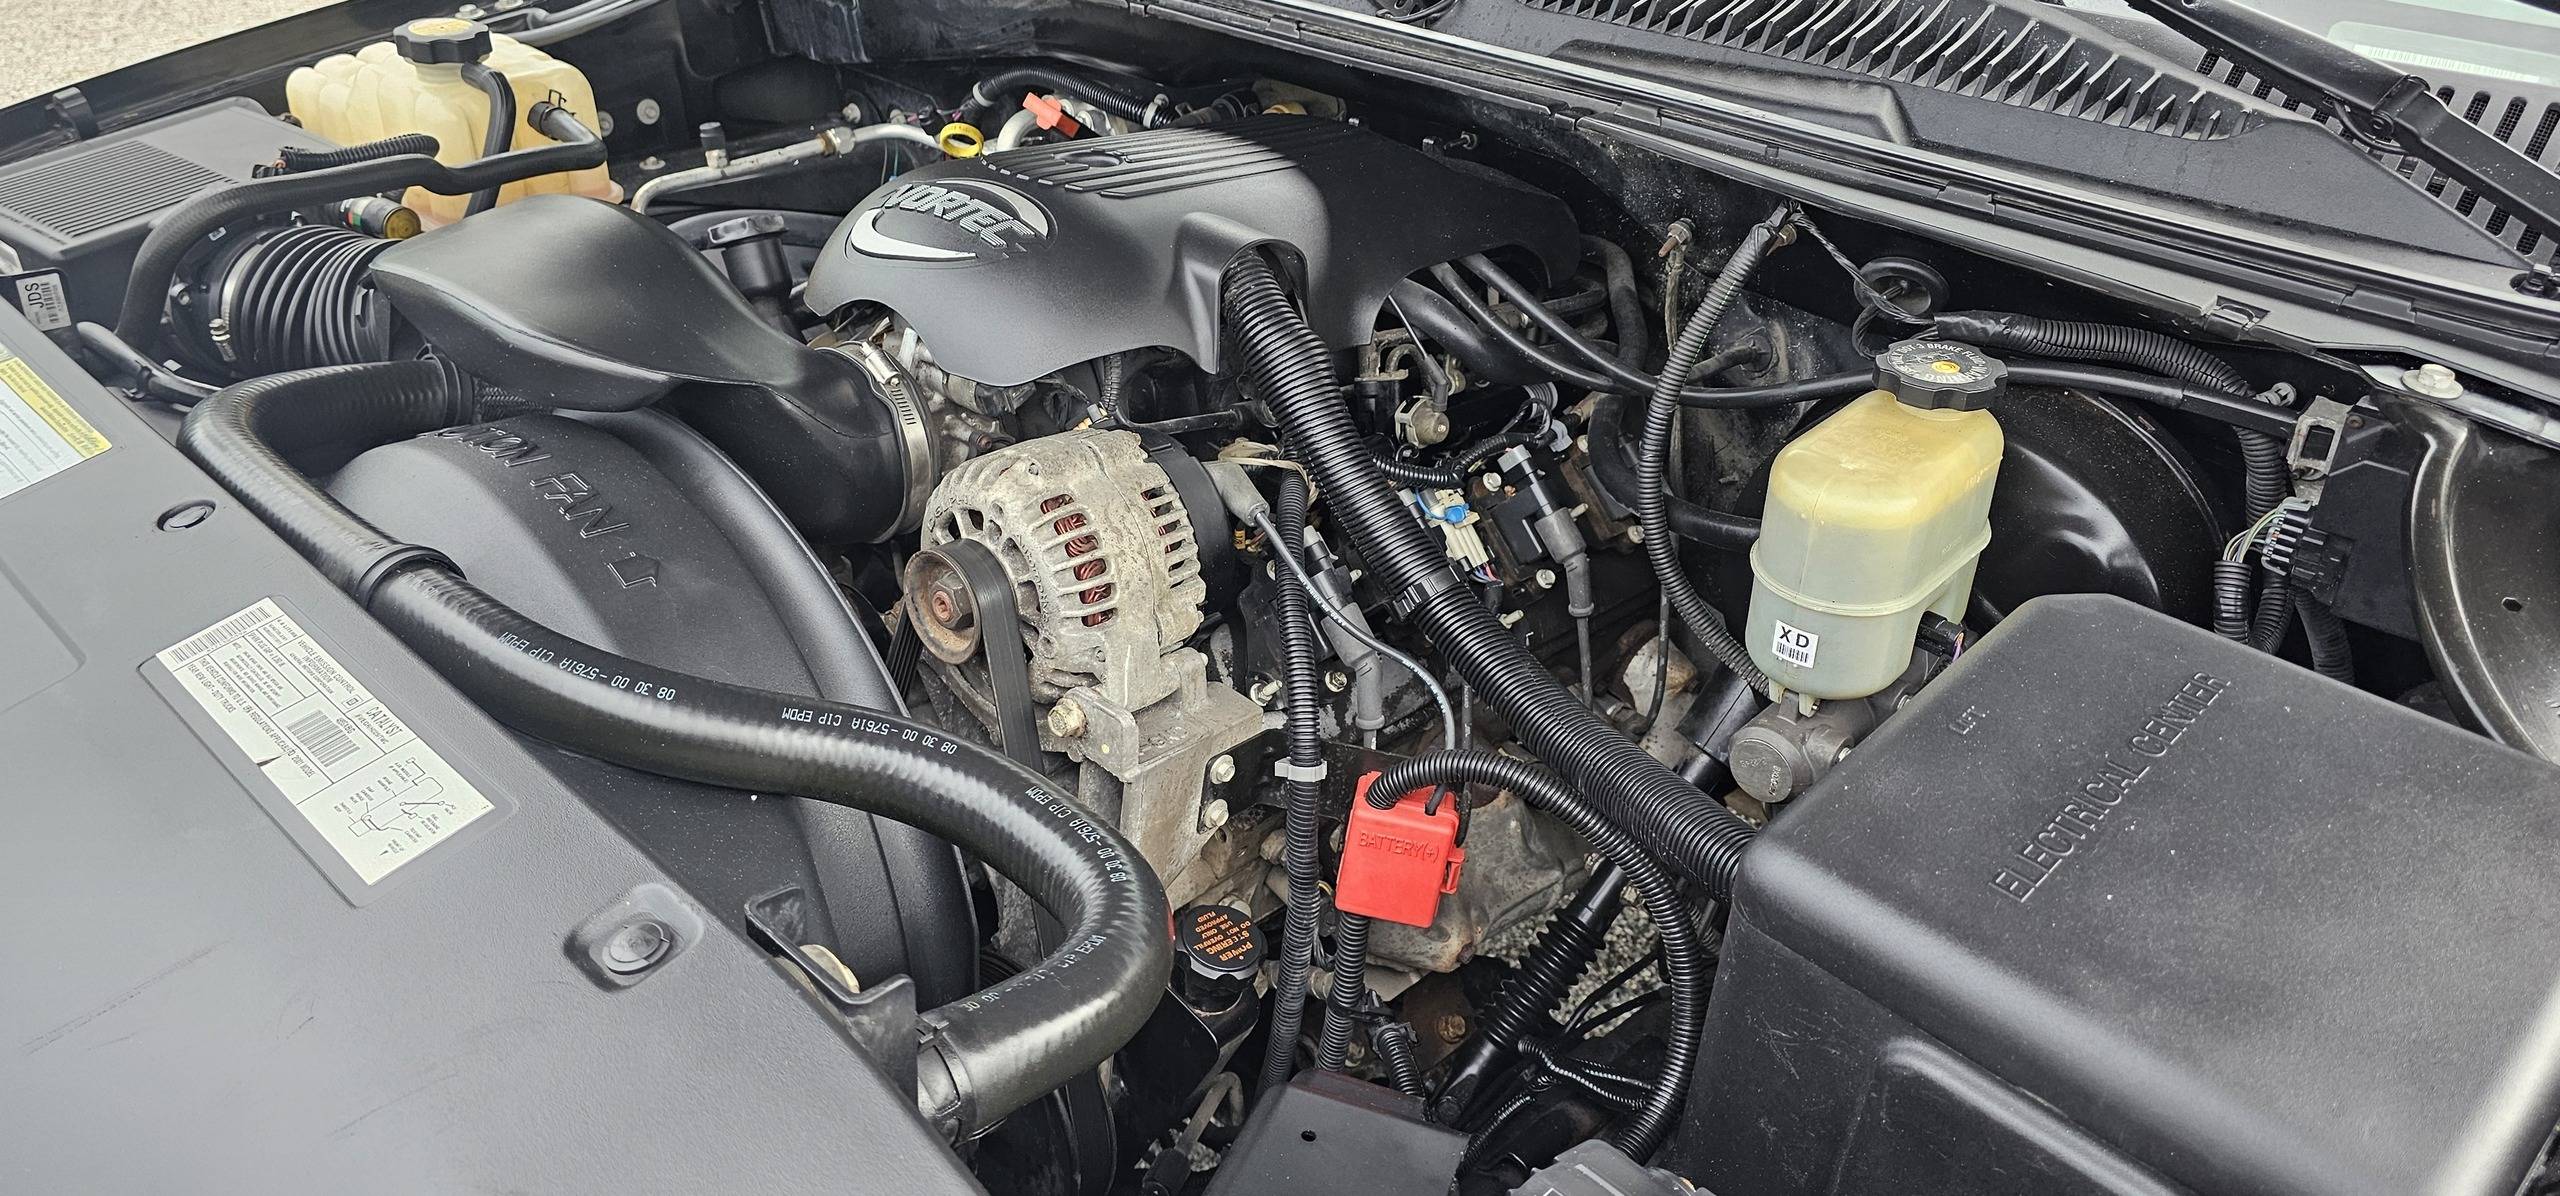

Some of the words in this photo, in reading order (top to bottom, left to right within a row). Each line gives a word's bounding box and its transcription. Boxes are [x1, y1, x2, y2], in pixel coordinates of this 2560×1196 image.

[874, 183, 1035, 249] VORTEC
[25, 282, 44, 308] JDS
[1926, 343, 1964, 353] BRAKE
[530, 472, 630, 538] FAN
[497, 631, 530, 652] EPDM
[296, 639, 317, 656] VEHICLE
[312, 654, 337, 675] EMISSION
[332, 673, 357, 694] CONTROL
[301, 654, 334, 683] INFORMATION
[611, 675, 630, 690] 00
[634, 681, 652, 696] 30
[657, 687, 676, 701] 08
[365, 706, 403, 737] CATALYST
[781, 706, 814, 723] EPDM
[818, 713, 843, 727] CIP
[902, 728, 919, 742] 00
[922, 734, 939, 748] 30
[941, 741, 958, 755] 08
[1988, 759, 2151, 903] ELECTRICAL
[2128, 671, 2232, 758] CENTER
[1025, 785, 1053, 806] EPDM
[1096, 847, 1115, 859] 00
[1104, 859, 1123, 871] 30
[1109, 871, 1127, 883] 08
[1195, 913, 1228, 933] APPROVED
[1197, 910, 1217, 923] FLUID
[1220, 920, 1233, 930] USE
[1226, 926, 1240, 936] NOT
[1240, 920, 1251, 929] DO
[1201, 928, 1218, 939] ONLY
[1193, 934, 1224, 951] OVERFILL
[1206, 930, 1250, 955] STEERING
[1219, 941, 1254, 962] POWER
